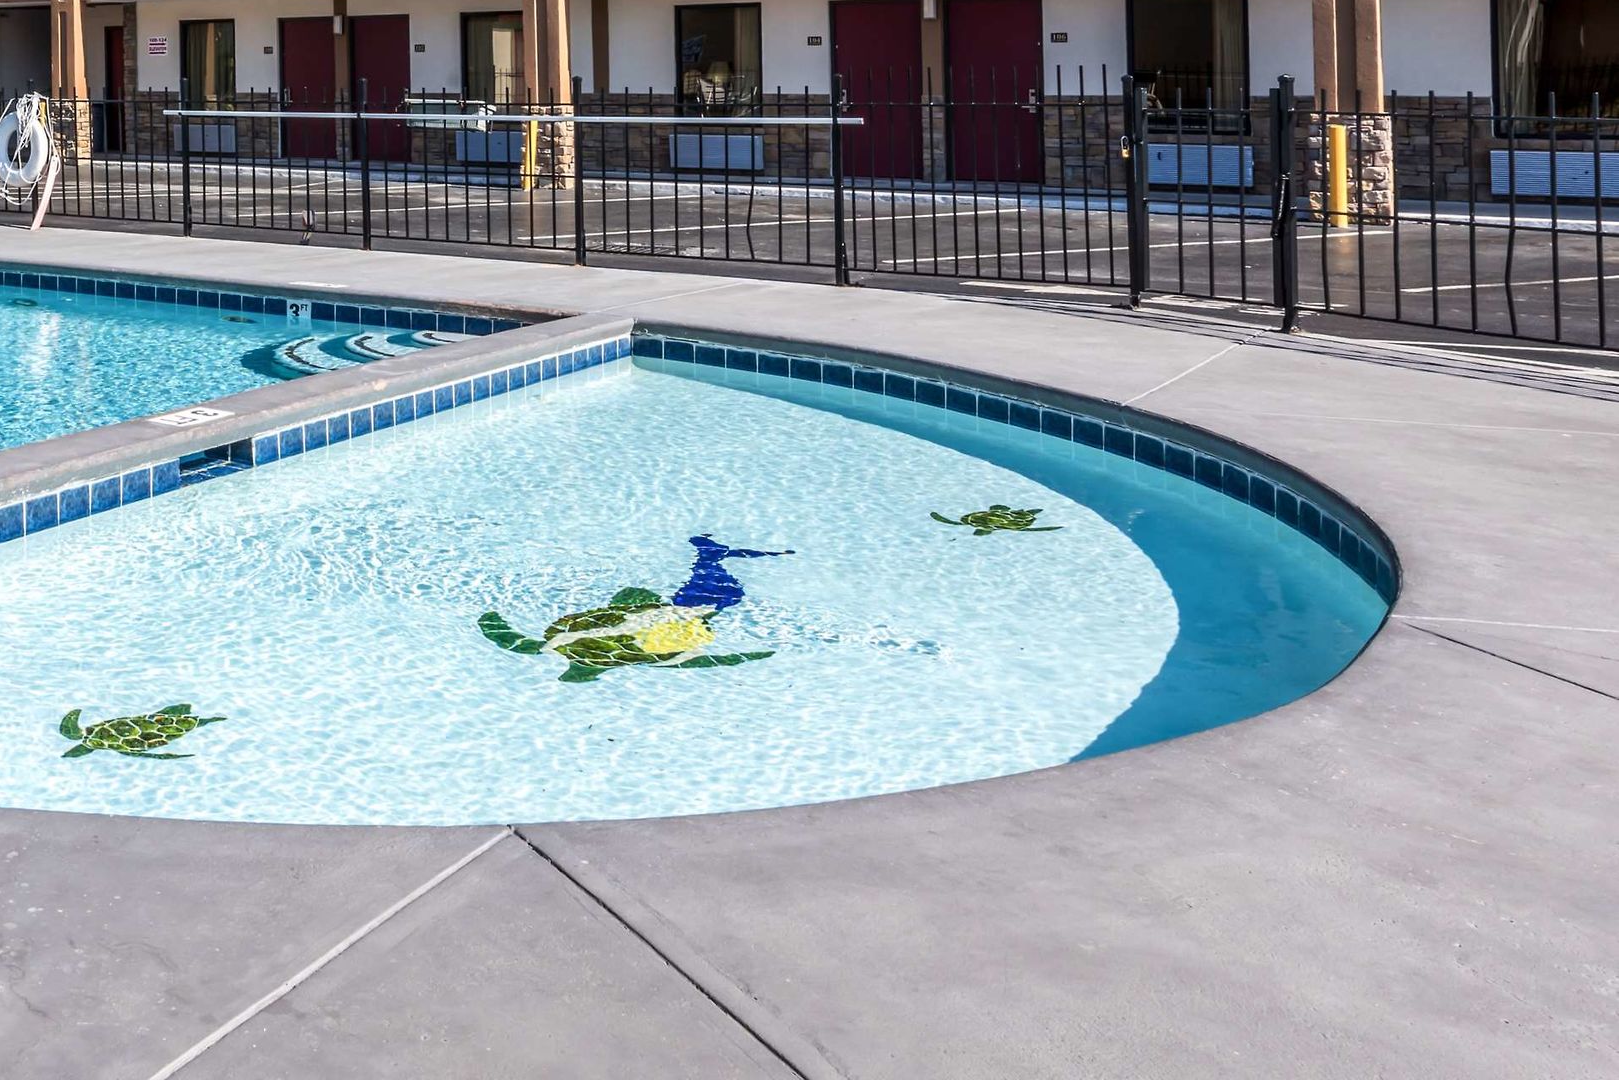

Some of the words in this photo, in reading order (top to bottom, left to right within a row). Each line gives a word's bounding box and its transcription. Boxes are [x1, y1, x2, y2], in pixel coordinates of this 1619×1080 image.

[289, 303, 300, 317] 3
[191, 409, 219, 417] 3
[159, 415, 198, 425] FT
